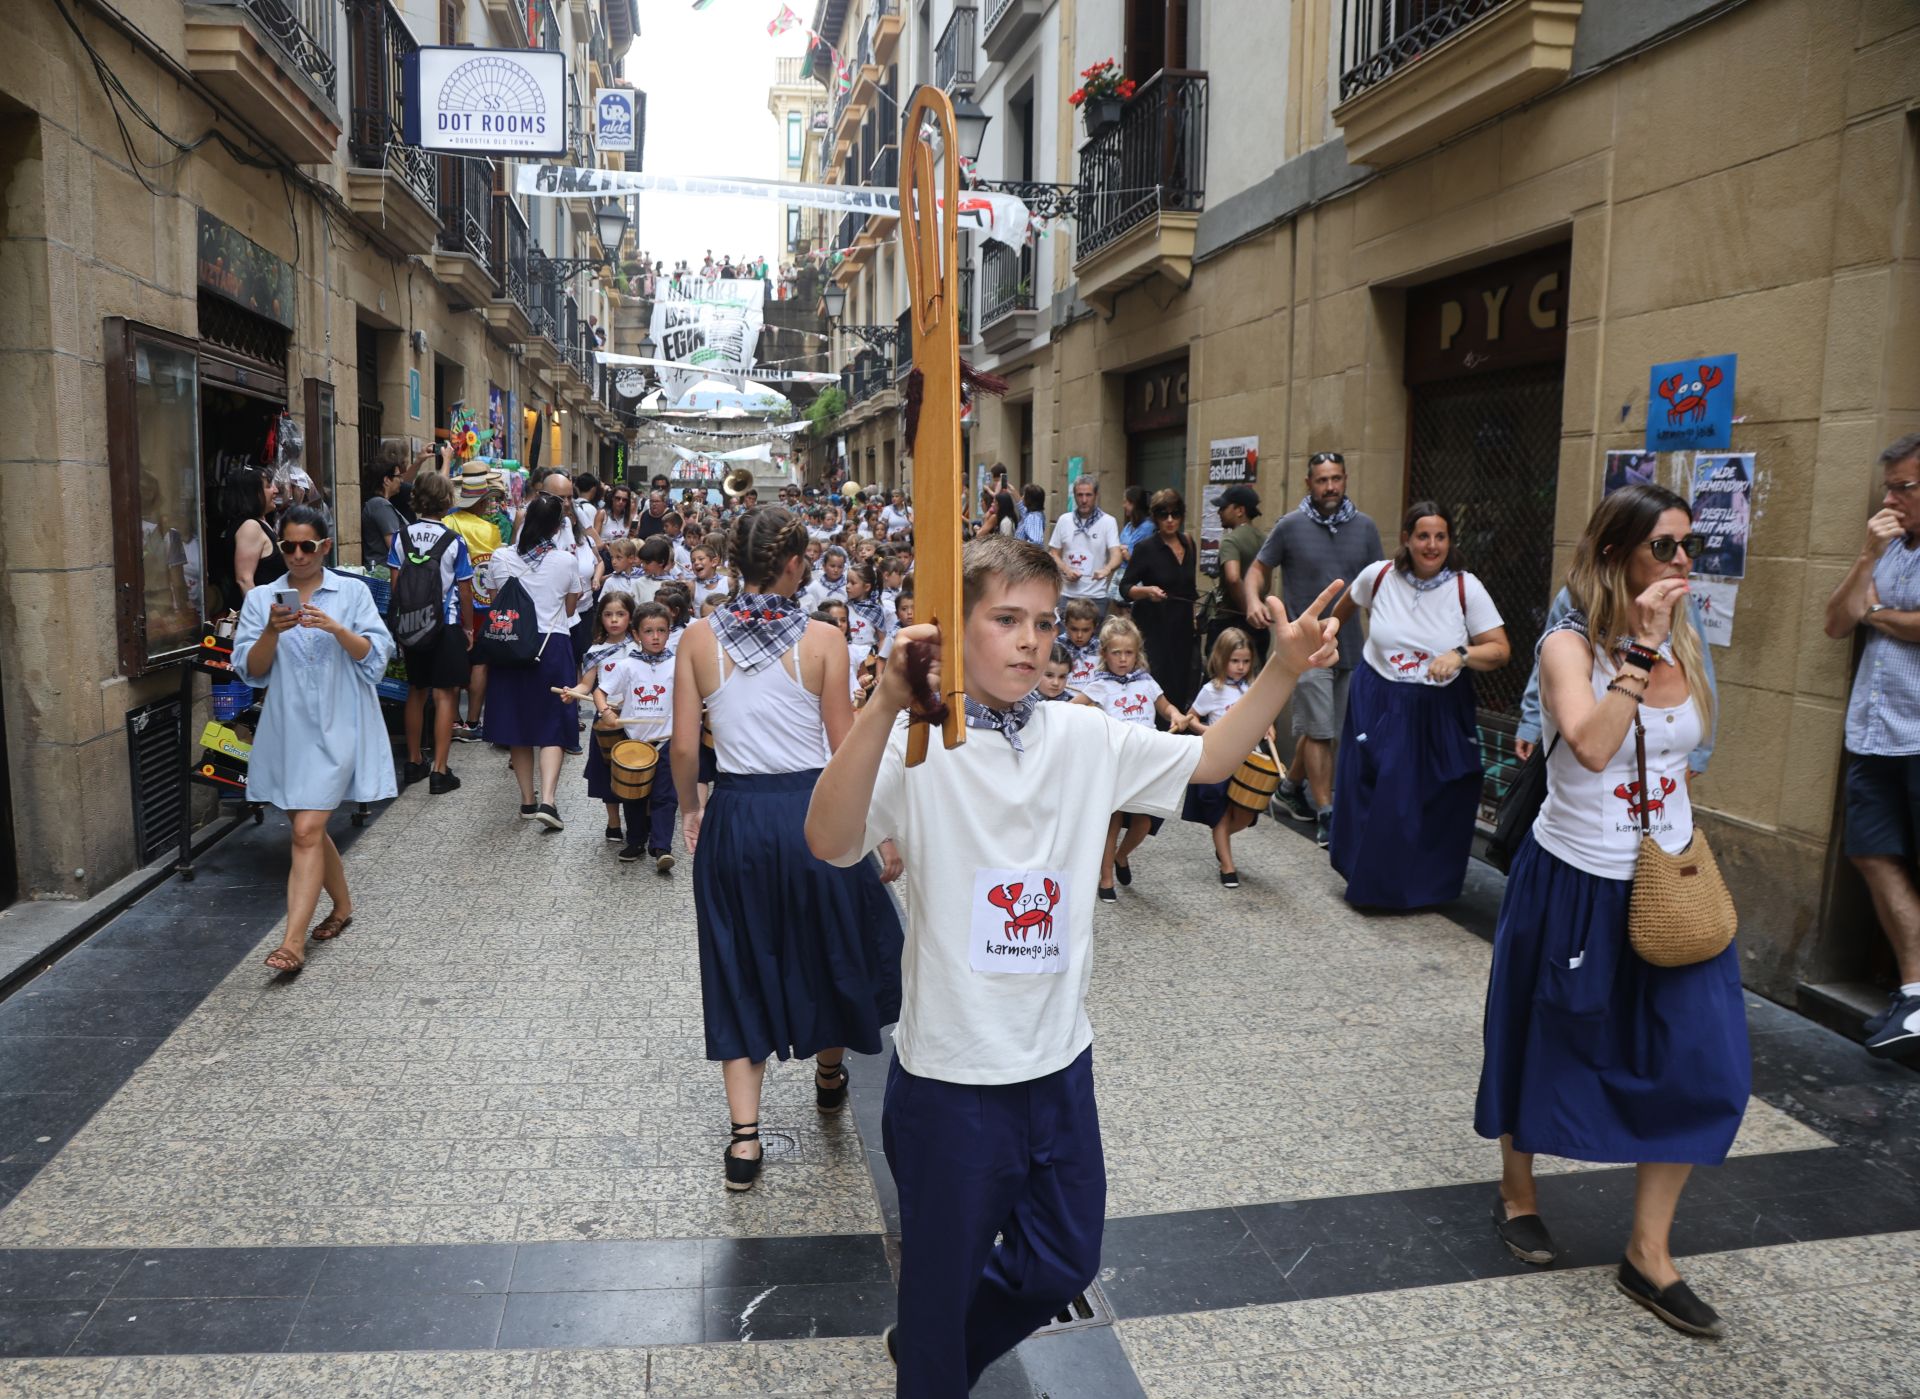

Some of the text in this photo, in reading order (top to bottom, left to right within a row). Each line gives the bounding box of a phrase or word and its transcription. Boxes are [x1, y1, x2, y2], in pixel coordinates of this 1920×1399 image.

[438, 113, 546, 134] DOT ROOMS
[662, 327, 706, 362] EGIN
[1211, 447, 1228, 458] EUSKAL
[1210, 458, 1246, 481] askatu!
[1711, 466, 1737, 478] ALDE
[1699, 508, 1737, 520] DESFILE
[398, 604, 435, 634] NIKE
[1616, 822, 1659, 835] karmgo
[986, 939, 1060, 960] karmengo jaiak
